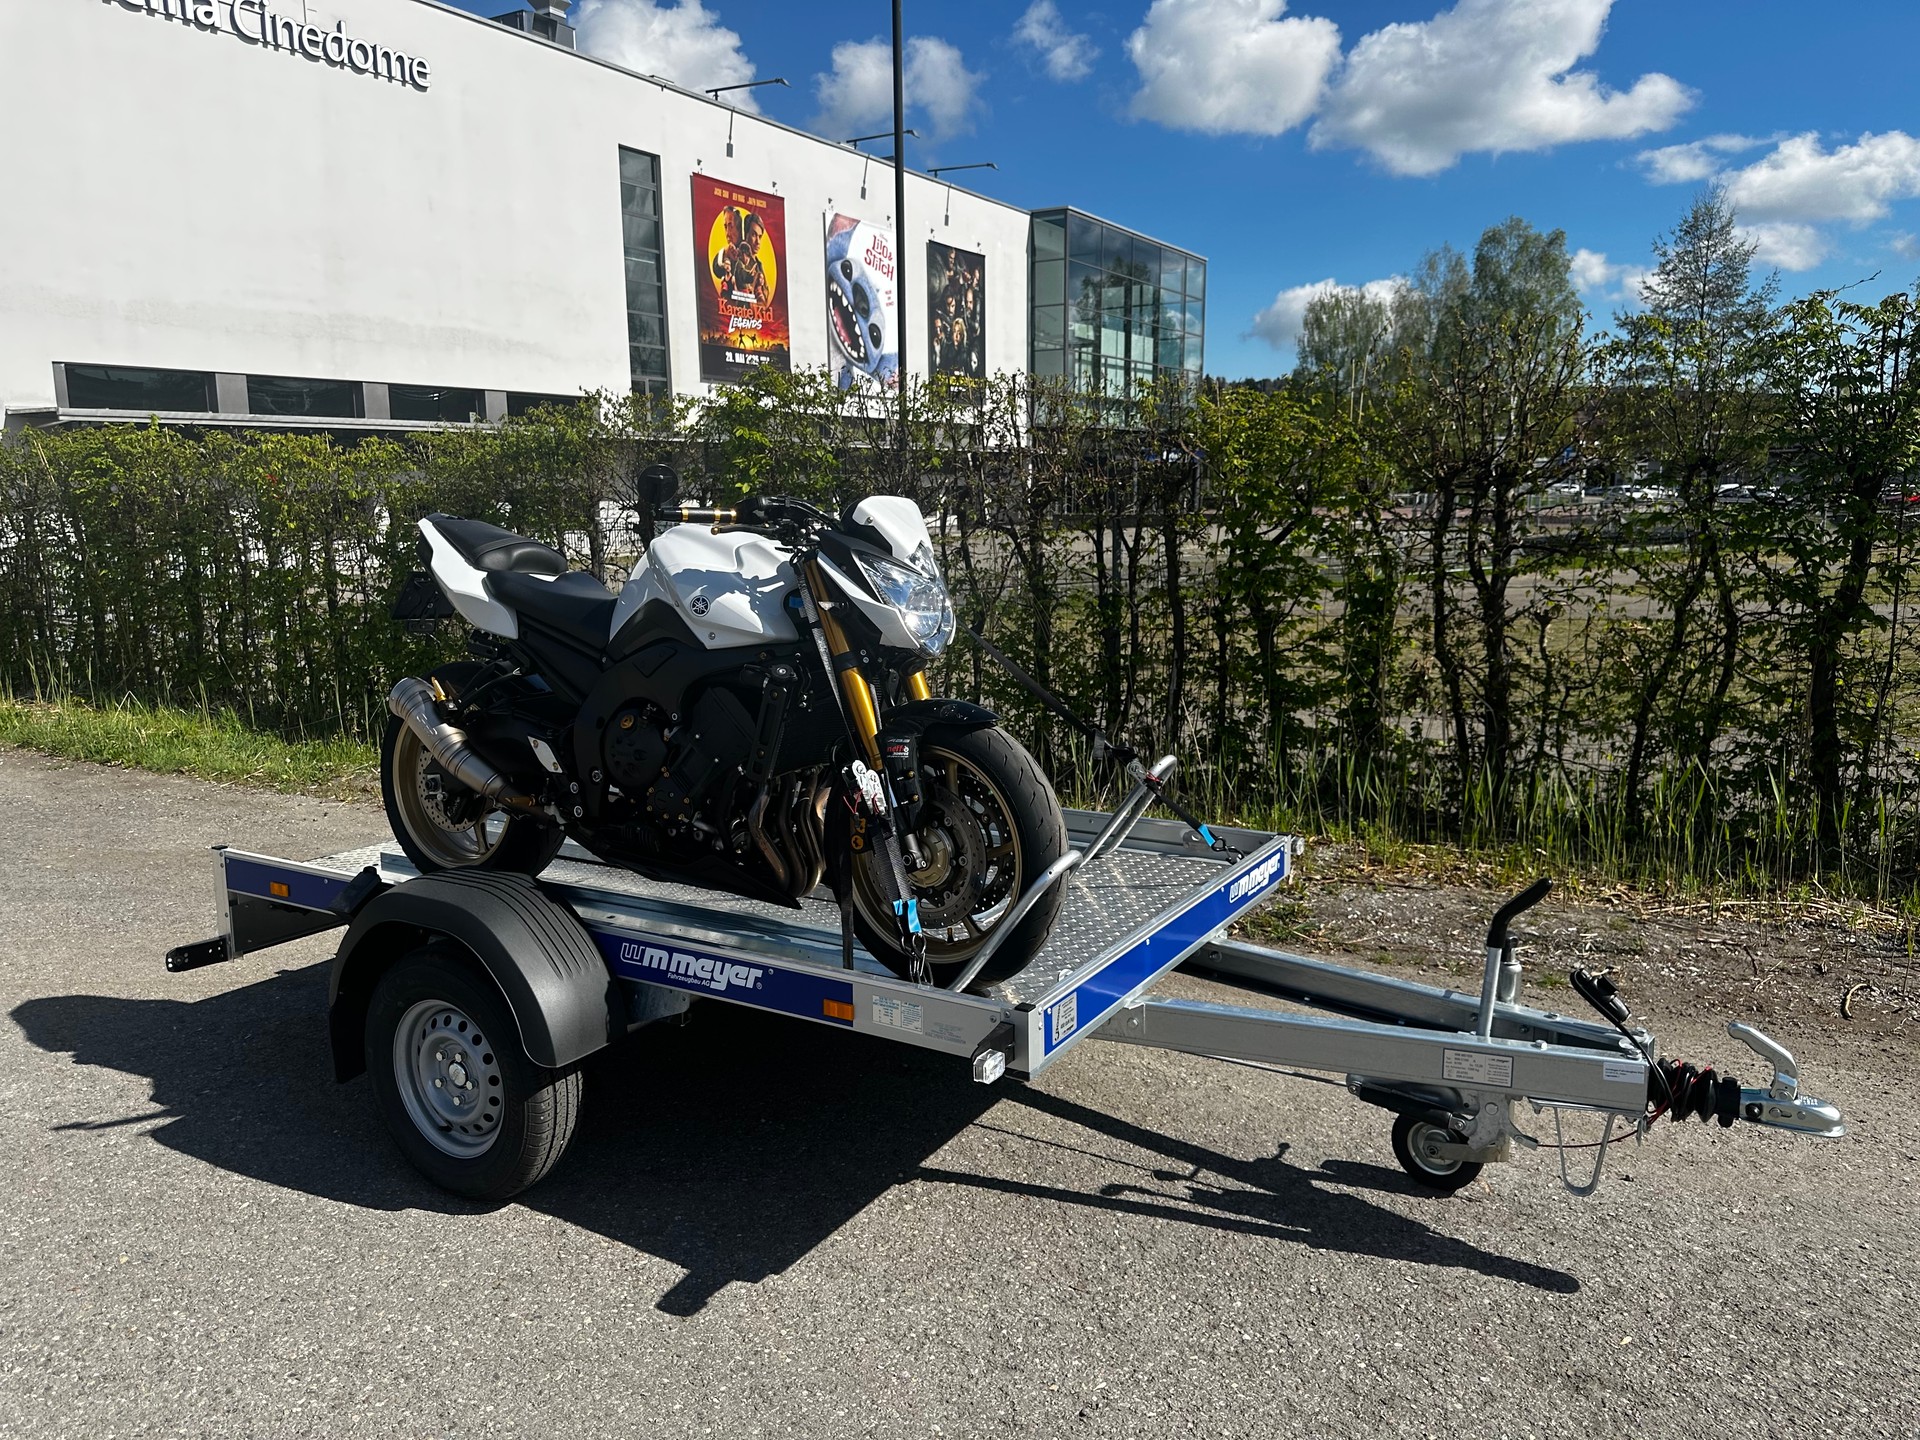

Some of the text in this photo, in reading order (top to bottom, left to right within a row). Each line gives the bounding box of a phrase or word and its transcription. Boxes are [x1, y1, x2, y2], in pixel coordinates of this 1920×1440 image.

[232, 0, 431, 88] Cinedome
[718, 298, 774, 322] Karate Kid
[667, 972, 702, 985] Fahrzeugbau
[669, 952, 763, 991] meyer
